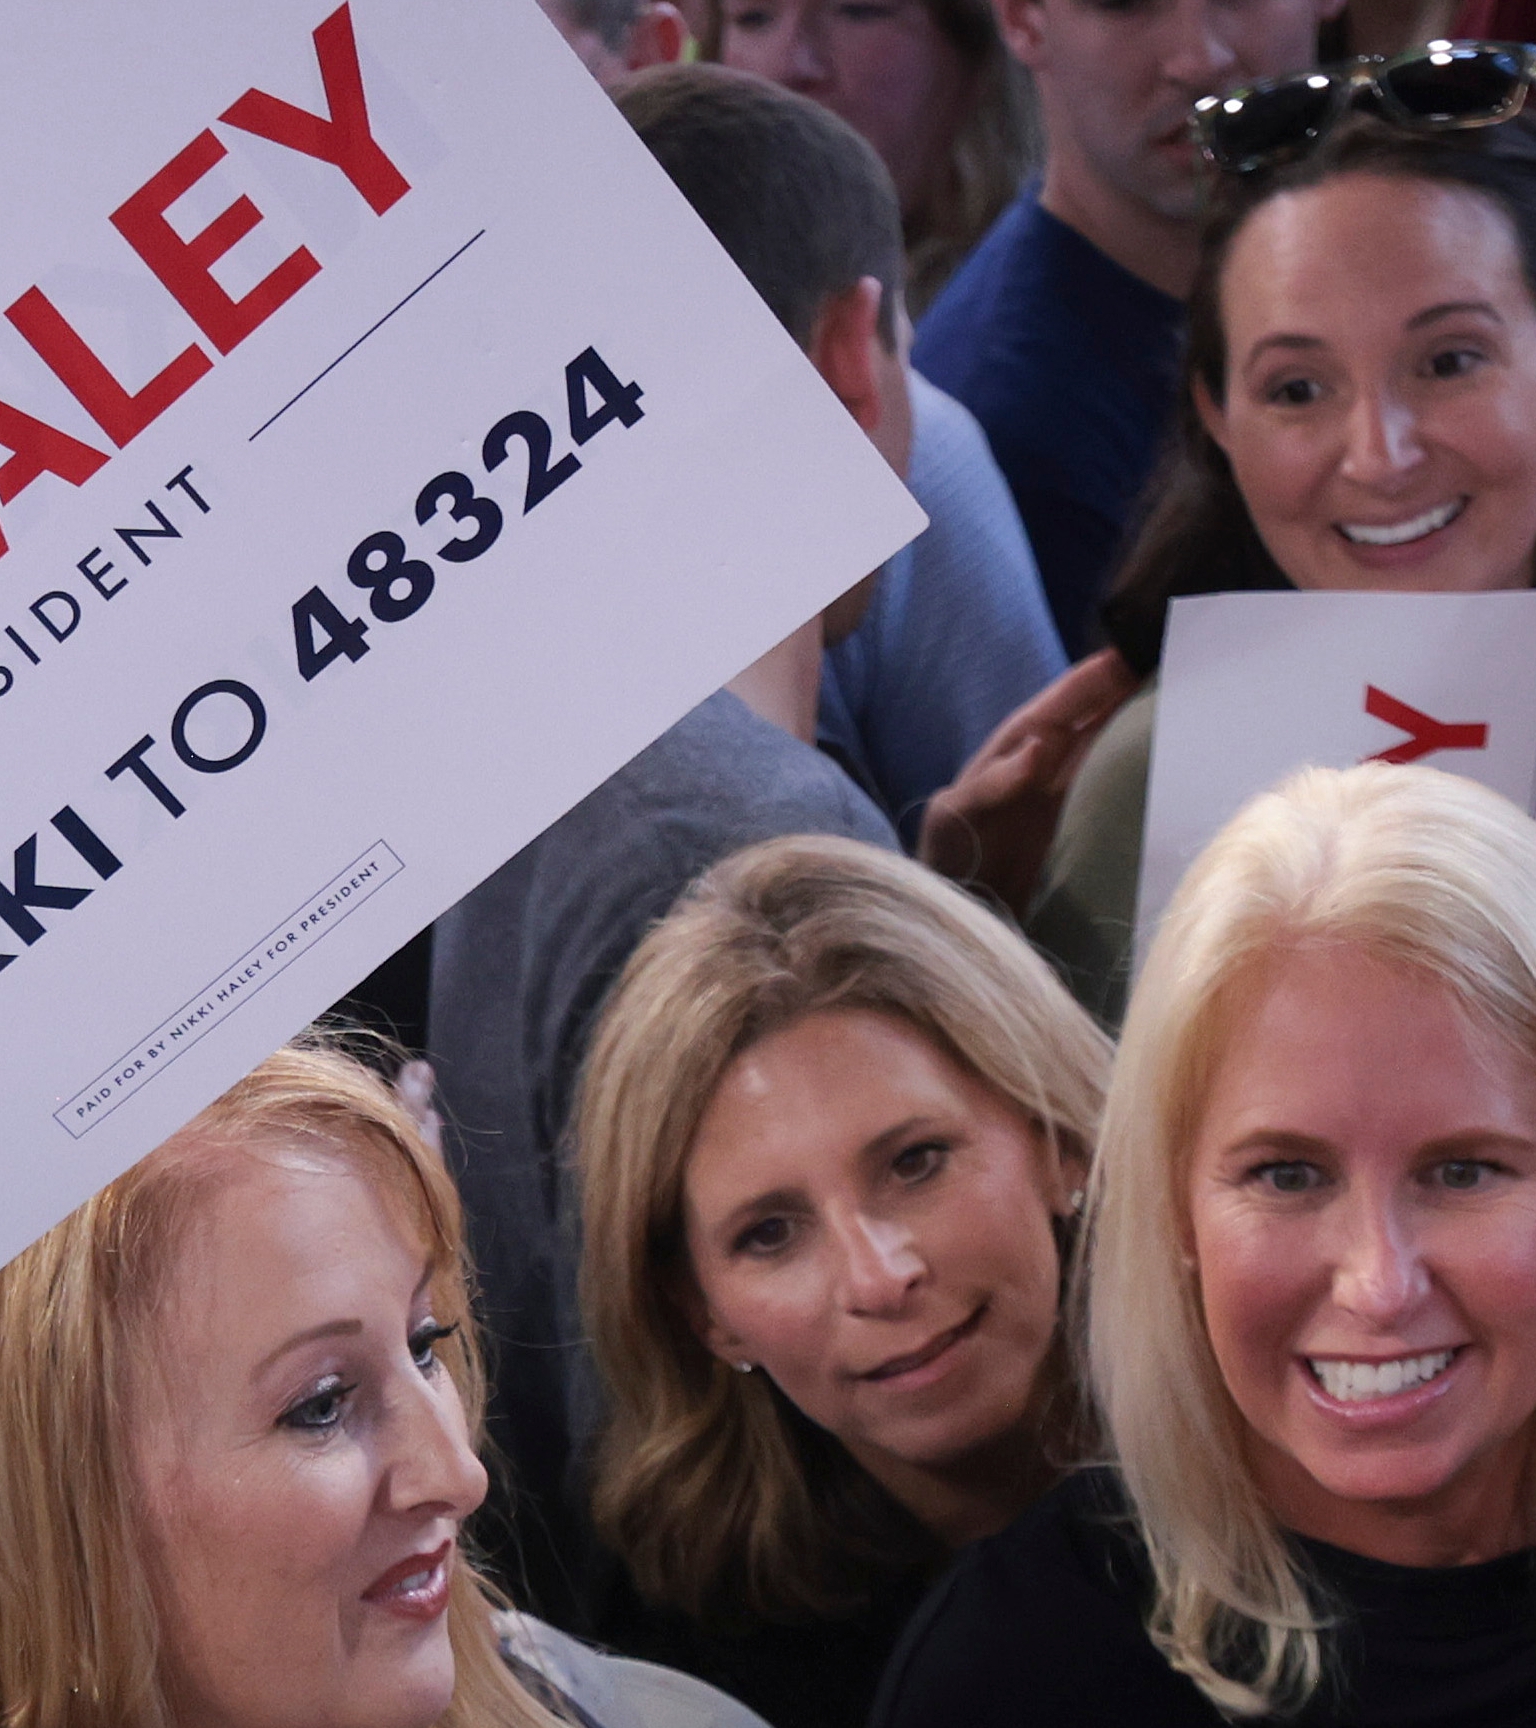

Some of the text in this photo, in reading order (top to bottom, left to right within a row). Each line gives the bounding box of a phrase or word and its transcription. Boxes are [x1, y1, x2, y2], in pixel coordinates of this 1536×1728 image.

[105, 680, 266, 819] TO
[292, 346, 645, 682] 48324
[76, 860, 381, 1118] PAID FOR BY NIKKI HALEY FOR PRESIDENT
